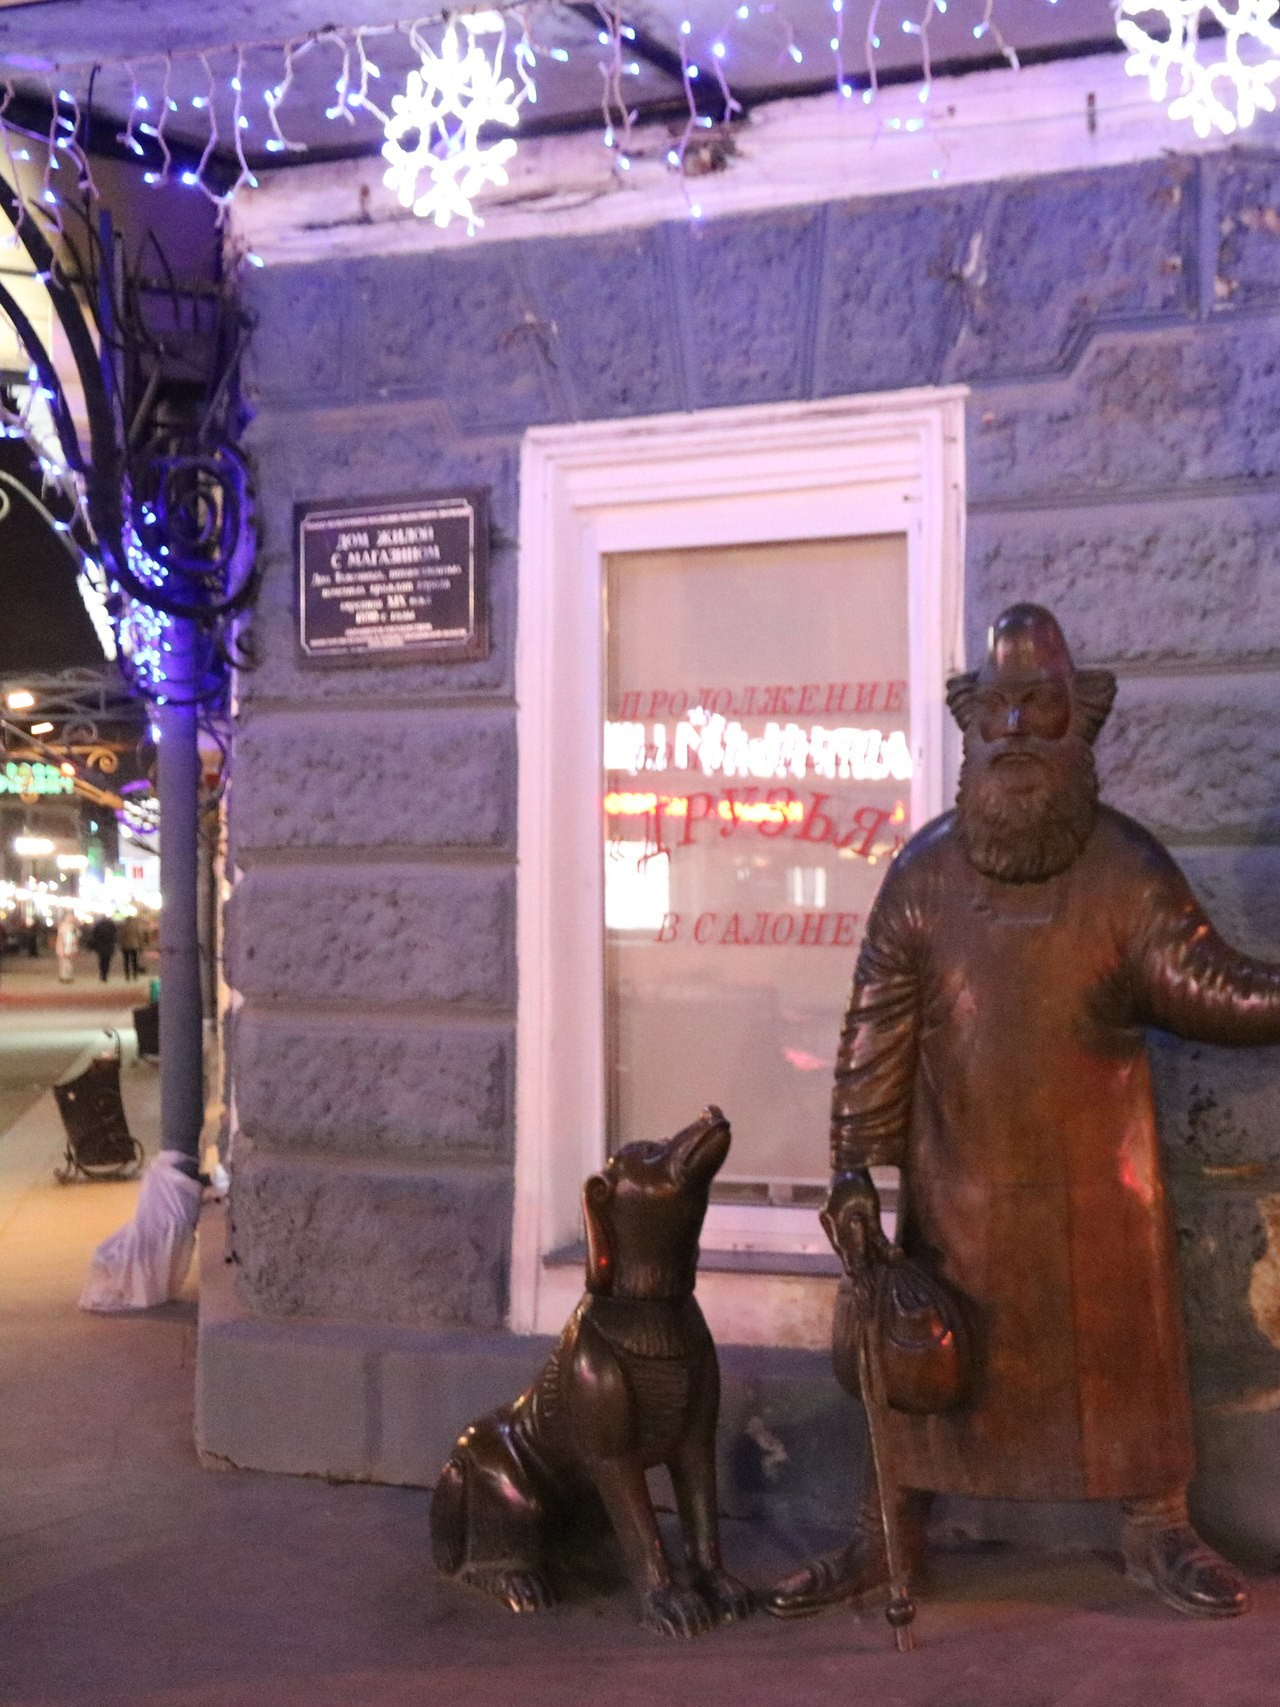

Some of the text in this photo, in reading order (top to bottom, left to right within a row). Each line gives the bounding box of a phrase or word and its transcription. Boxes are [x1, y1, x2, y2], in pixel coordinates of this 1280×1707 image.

[336, 531, 370, 551] ДОМ
[330, 552, 343, 570] С
[617, 680, 909, 720] ПРОДОЛЖЕНИЕ
[654, 911, 861, 947] В САЛОНЕ
